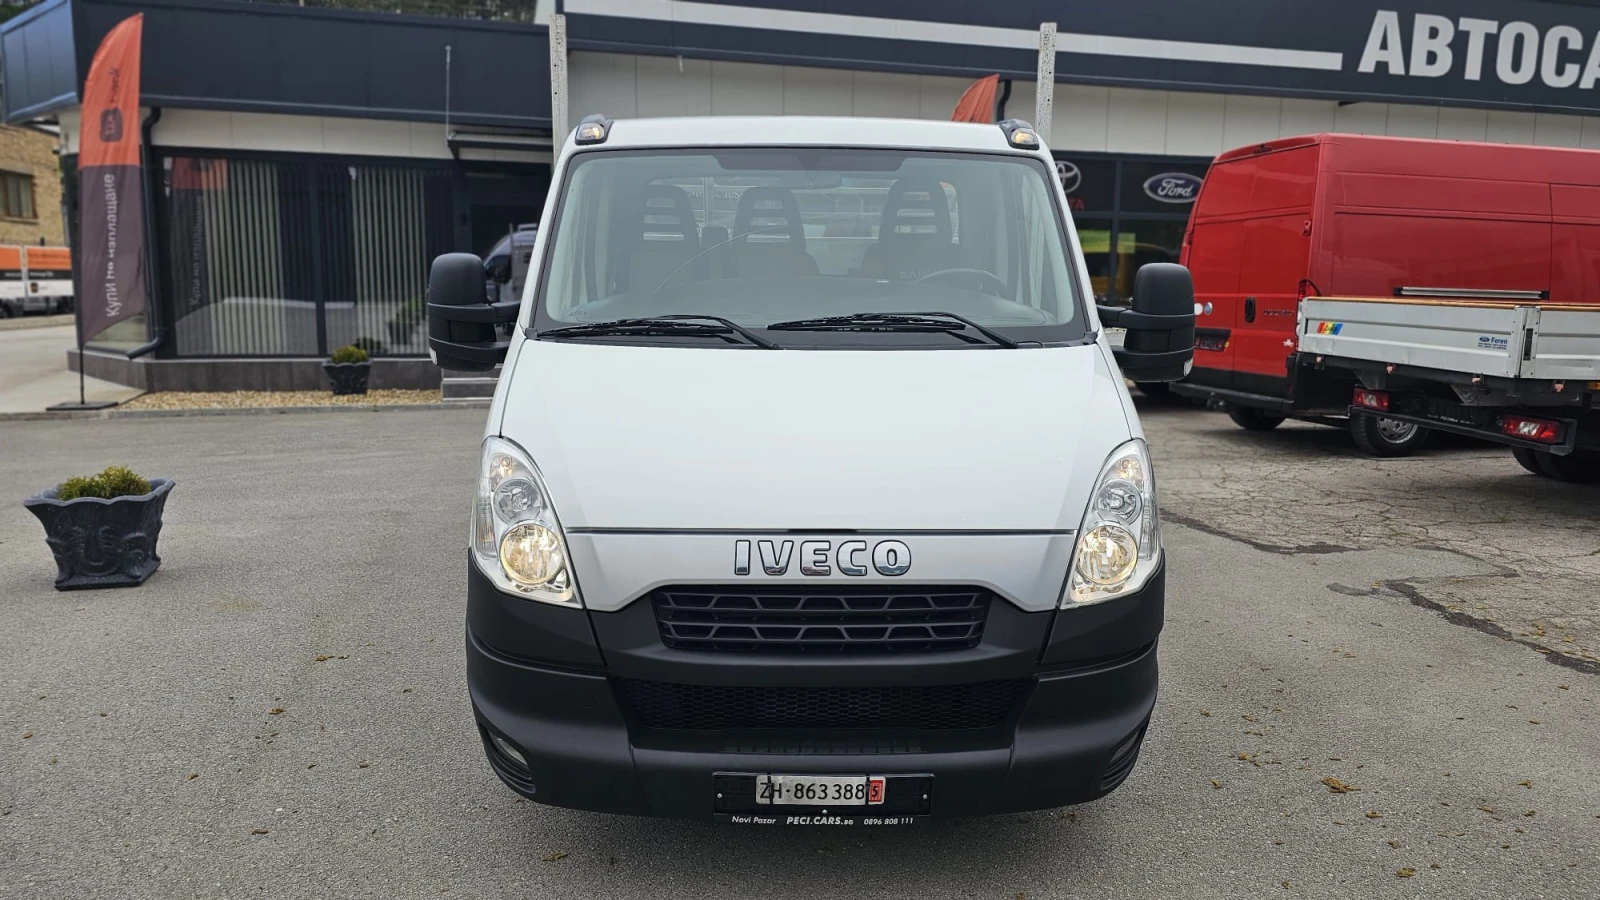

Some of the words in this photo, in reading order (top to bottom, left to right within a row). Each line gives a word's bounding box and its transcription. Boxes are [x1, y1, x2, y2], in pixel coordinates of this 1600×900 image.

[1157, 178, 1194, 197] Ford
[105, 283, 122, 317] Купи
[734, 539, 912, 576] IVECO
[731, 815, 751, 824] Novi
[753, 816, 777, 825] Pazar
